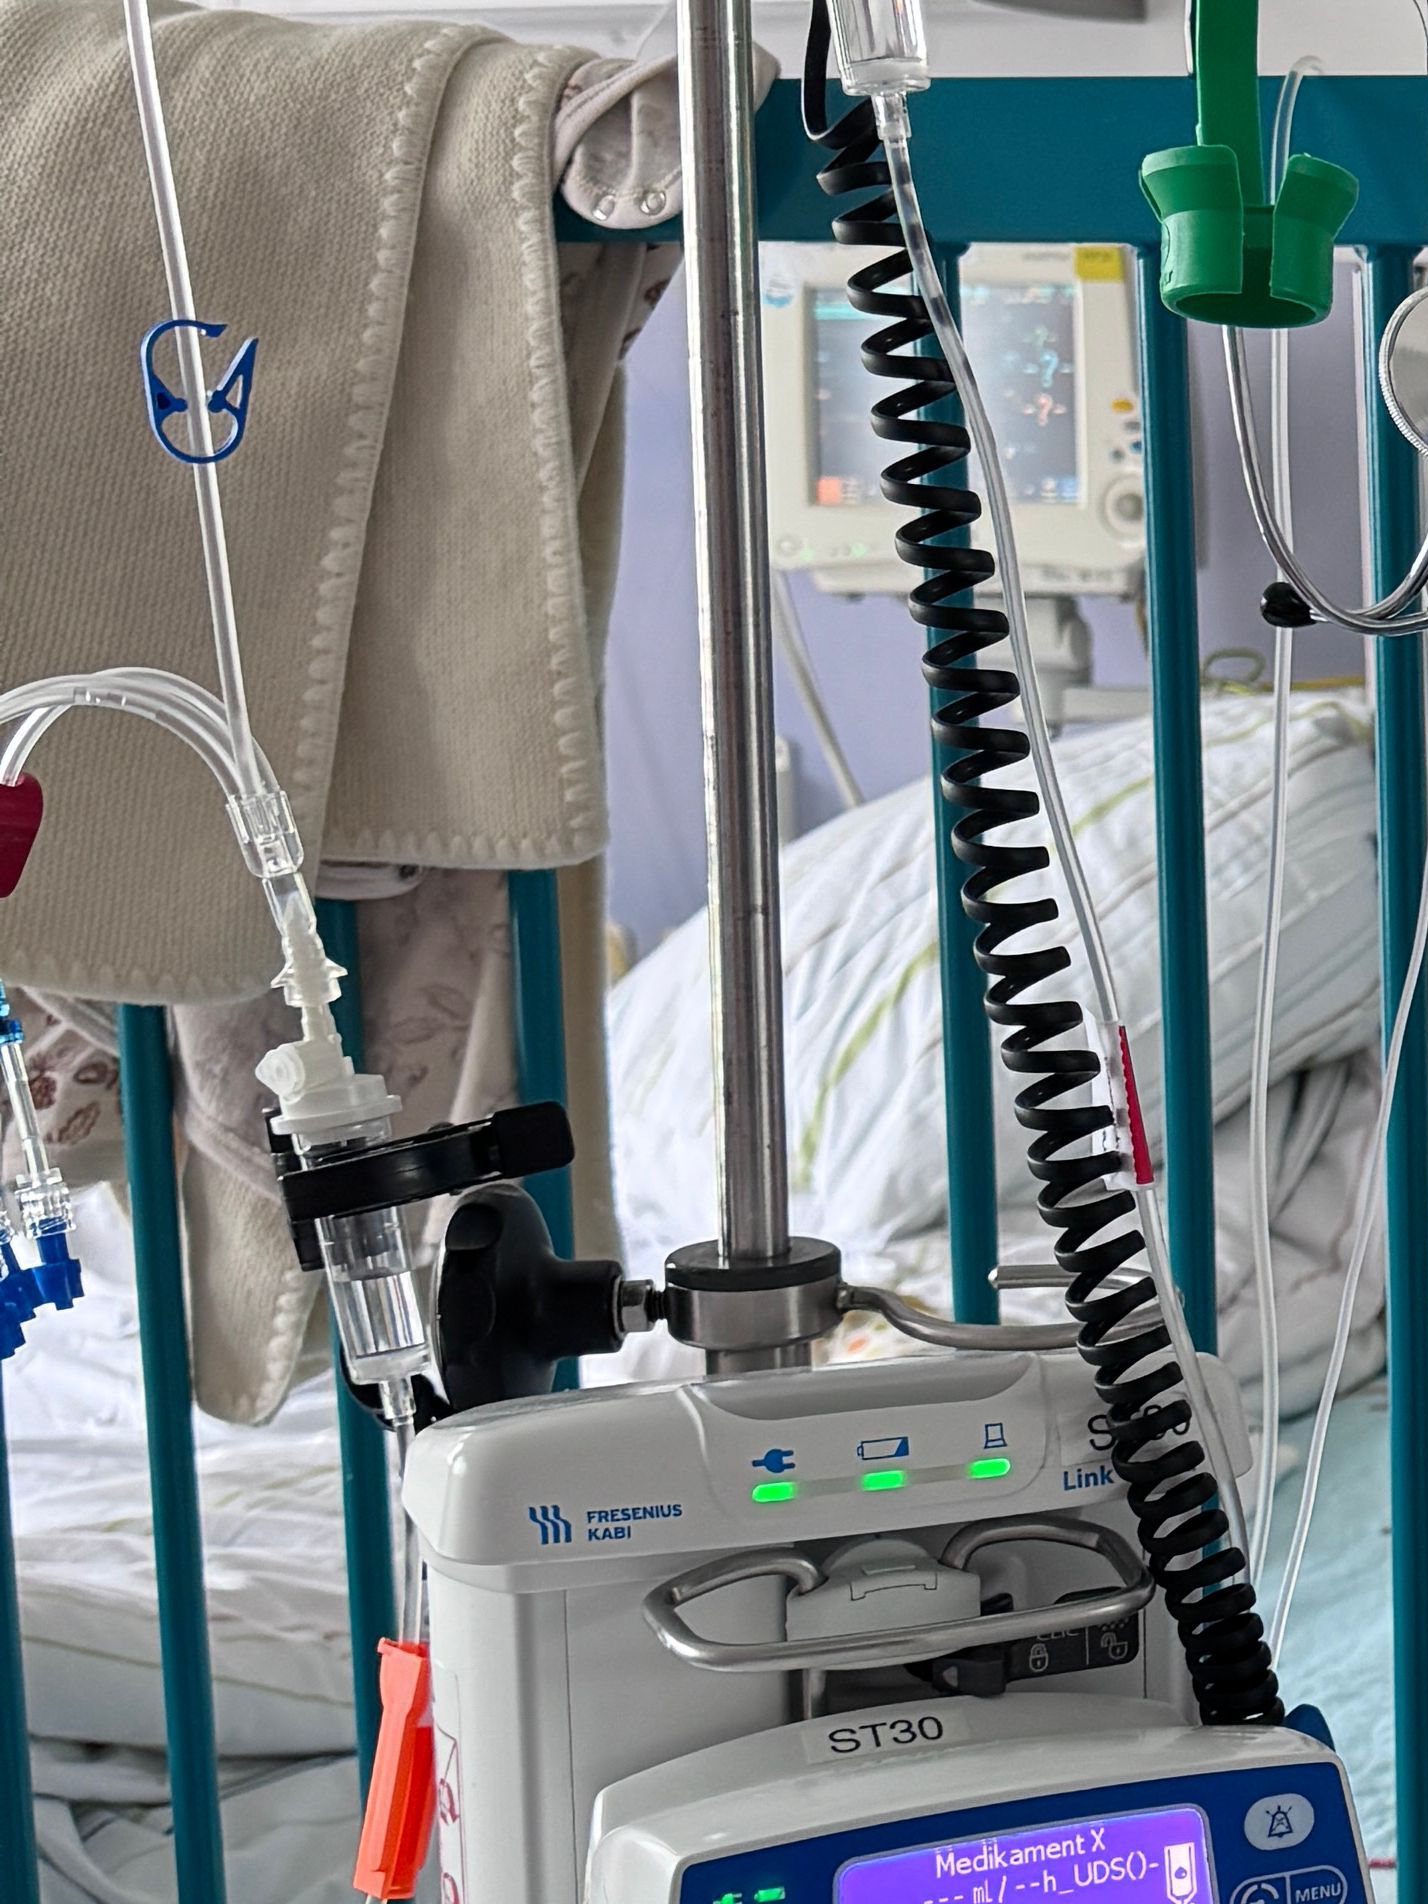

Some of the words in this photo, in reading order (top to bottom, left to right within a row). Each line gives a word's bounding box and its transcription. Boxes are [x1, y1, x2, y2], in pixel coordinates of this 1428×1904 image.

[1063, 1465, 1115, 1491] Link
[586, 1503, 683, 1524] FRESENIUS
[587, 1526, 632, 1541] KABI
[828, 1716, 944, 1754] ST30
[935, 1833, 1085, 1879] Medikament
[1090, 1827, 1106, 1852] X
[1295, 1882, 1342, 1904] MENU
